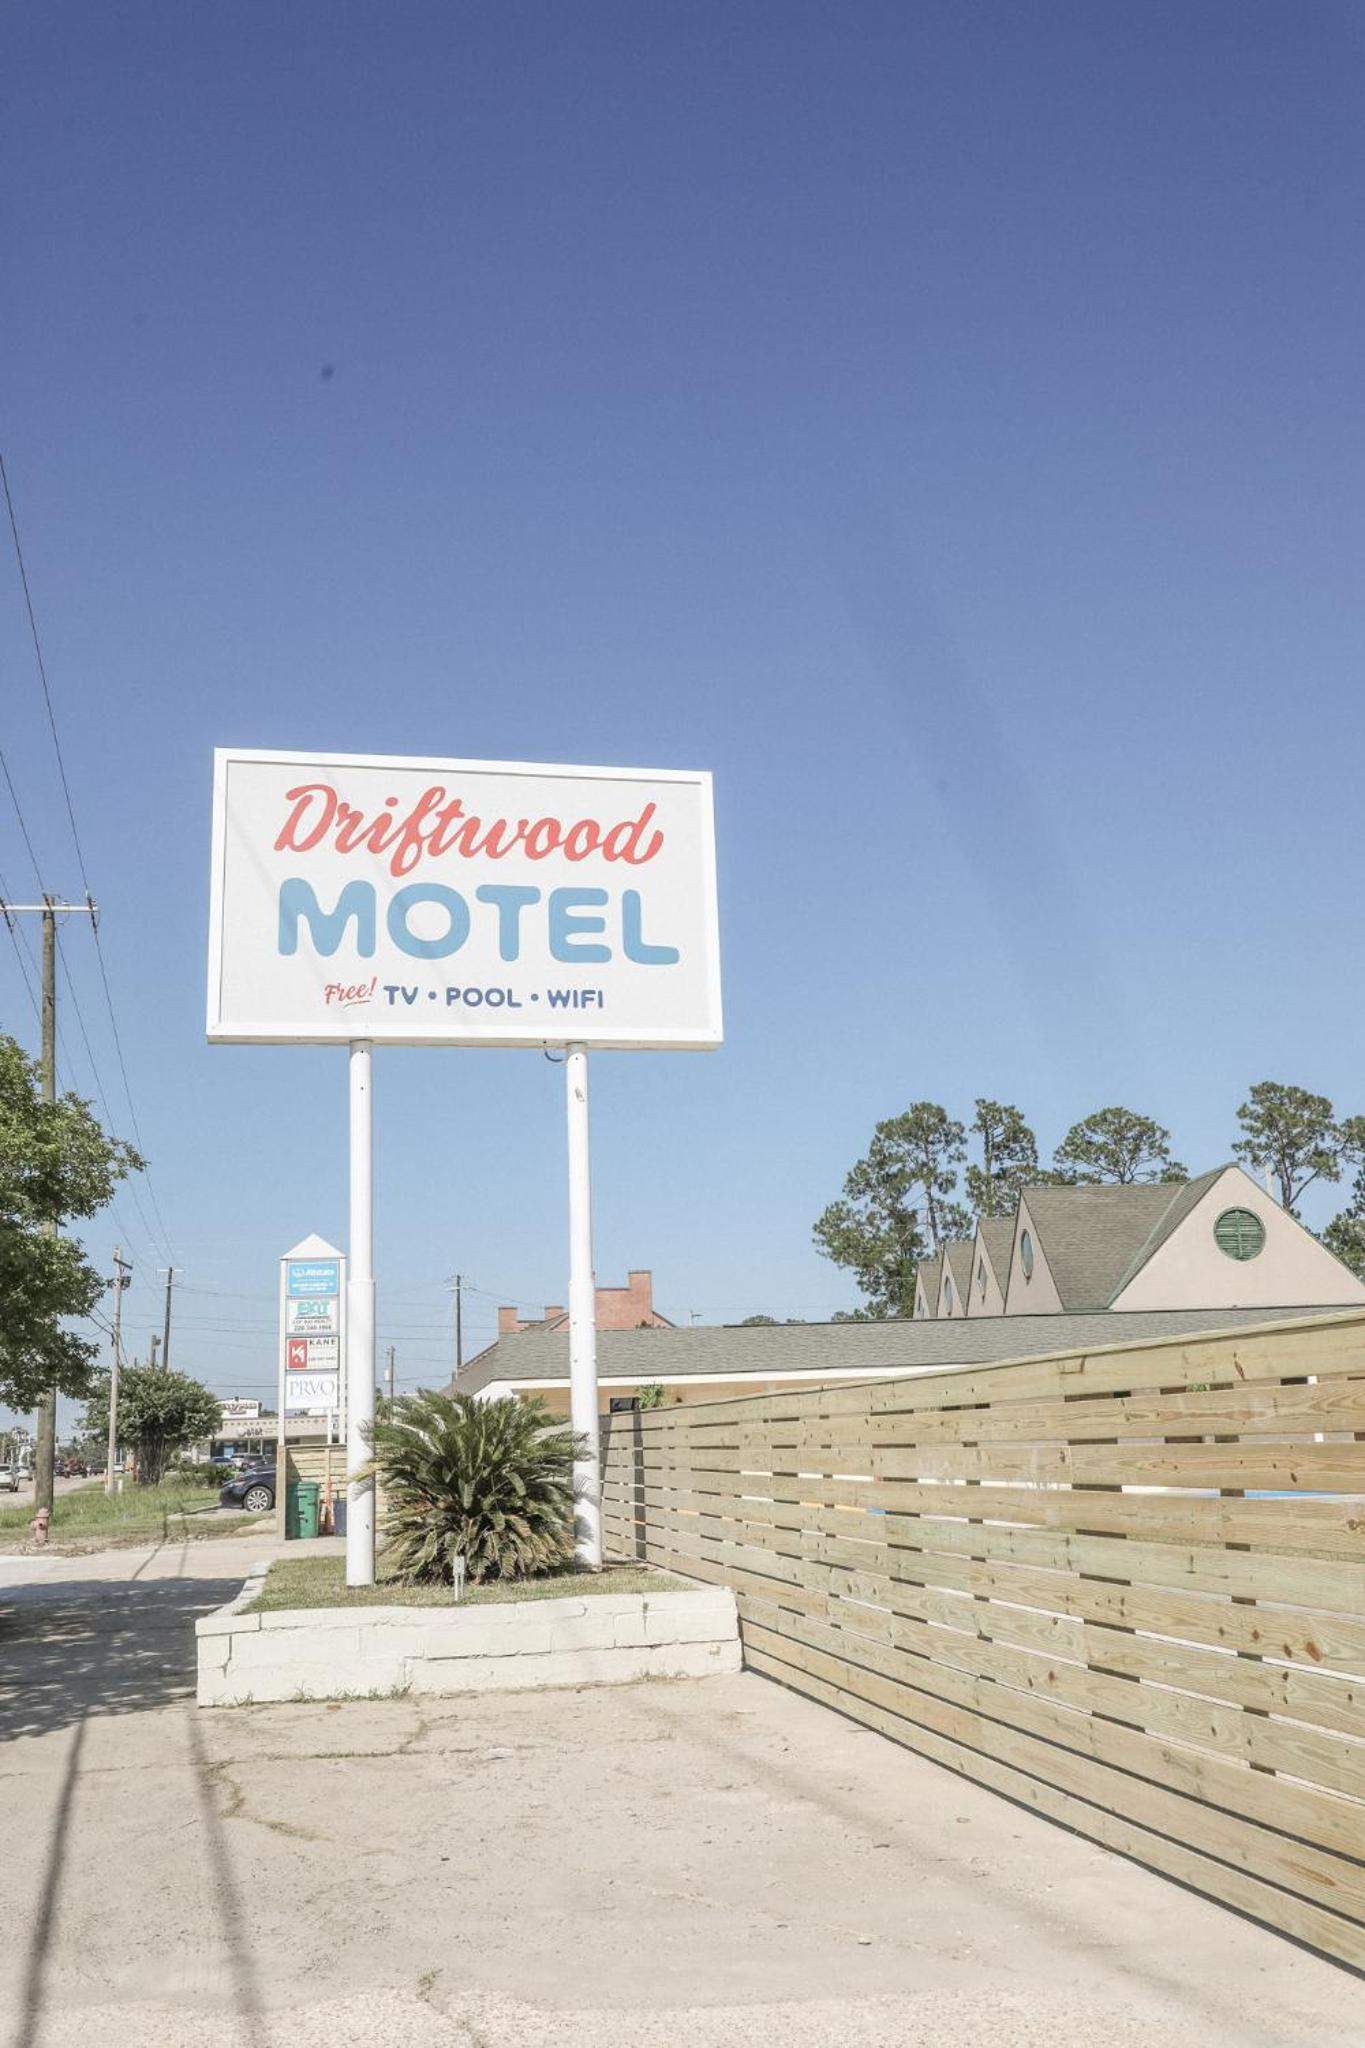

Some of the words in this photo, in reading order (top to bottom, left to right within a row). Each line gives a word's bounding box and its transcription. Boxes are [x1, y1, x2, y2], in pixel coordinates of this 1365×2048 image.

[274, 784, 663, 877] Driftwood
[277, 877, 680, 966] MOTEL
[325, 977, 377, 1007] Free!
[383, 985, 418, 1005] TV
[446, 986, 522, 1008] POOL
[547, 989, 604, 1008] WIFI
[309, 1338, 337, 1346] KANE
